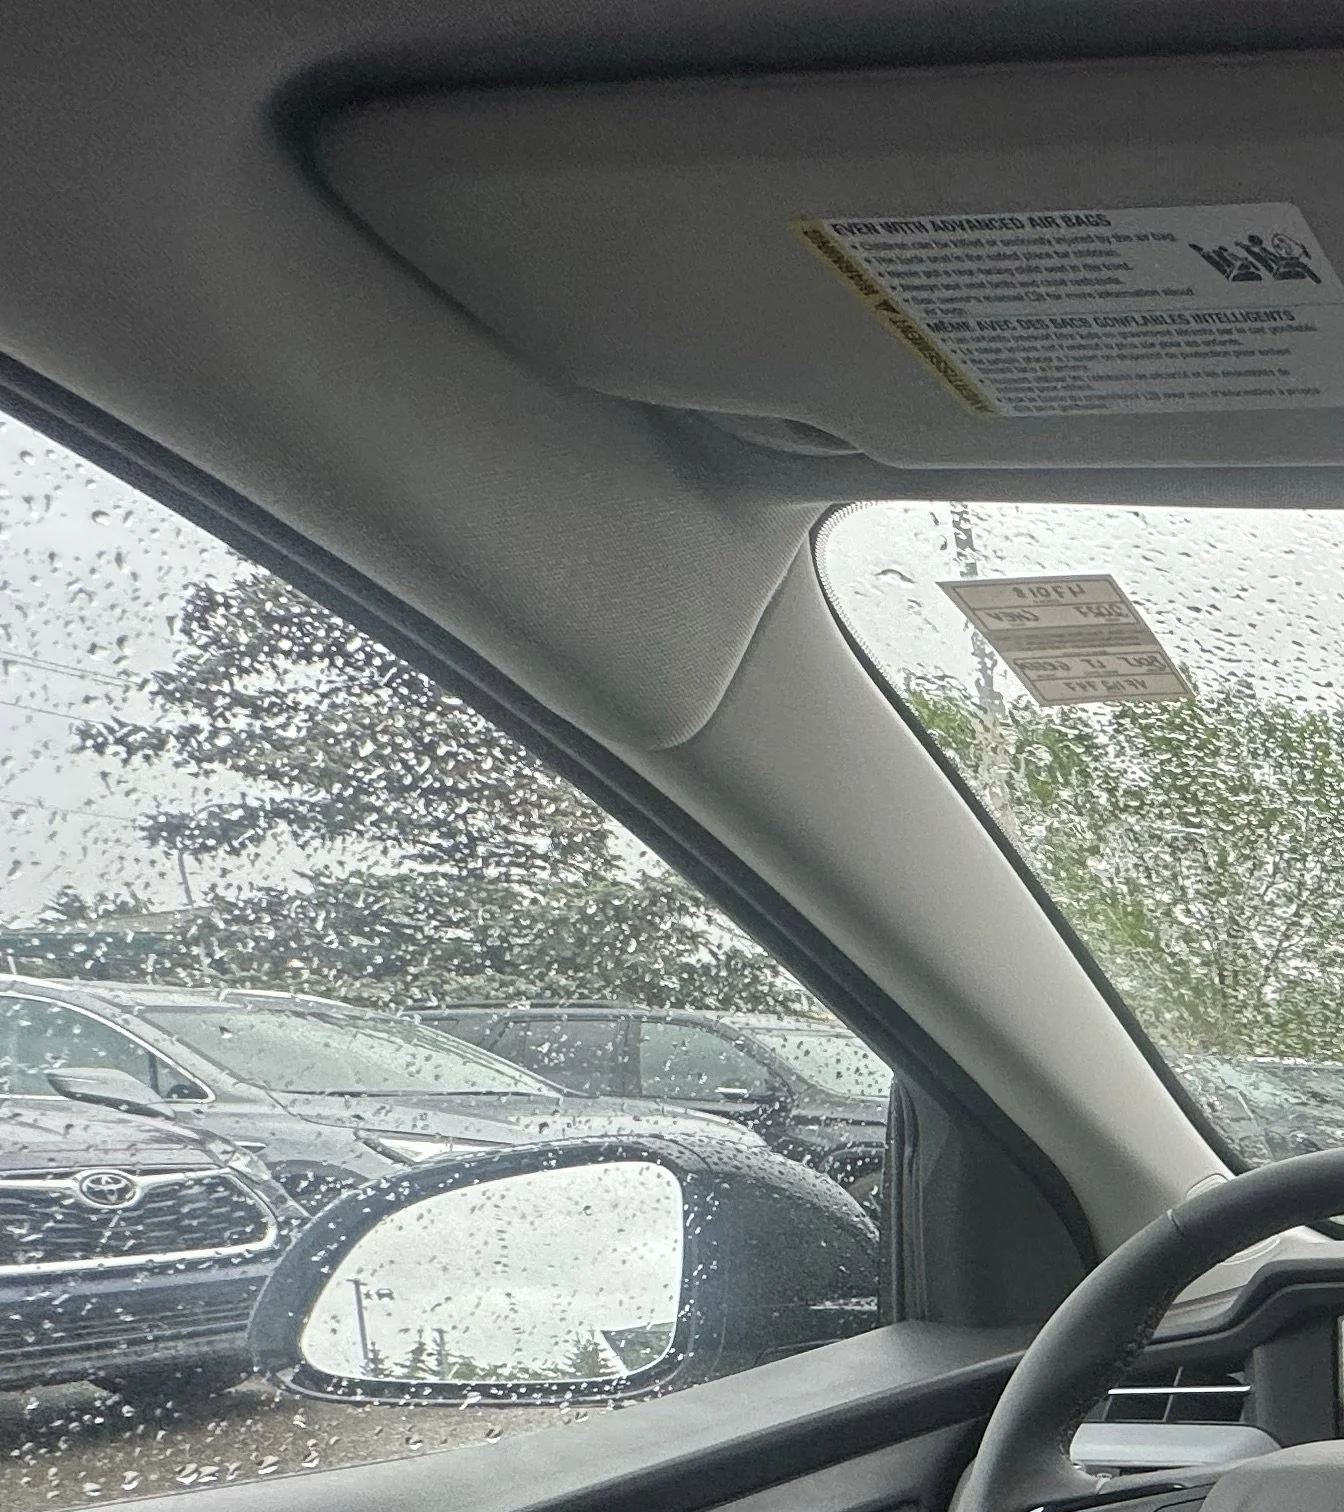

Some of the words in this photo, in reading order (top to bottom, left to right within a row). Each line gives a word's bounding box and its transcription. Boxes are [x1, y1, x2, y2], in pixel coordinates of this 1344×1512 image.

[828, 221, 882, 236] EVEN
[877, 219, 931, 234] WITH
[925, 215, 1027, 233] ADVANCED
[1023, 214, 1063, 229] AIR
[1058, 212, 1113, 227] BAGS
